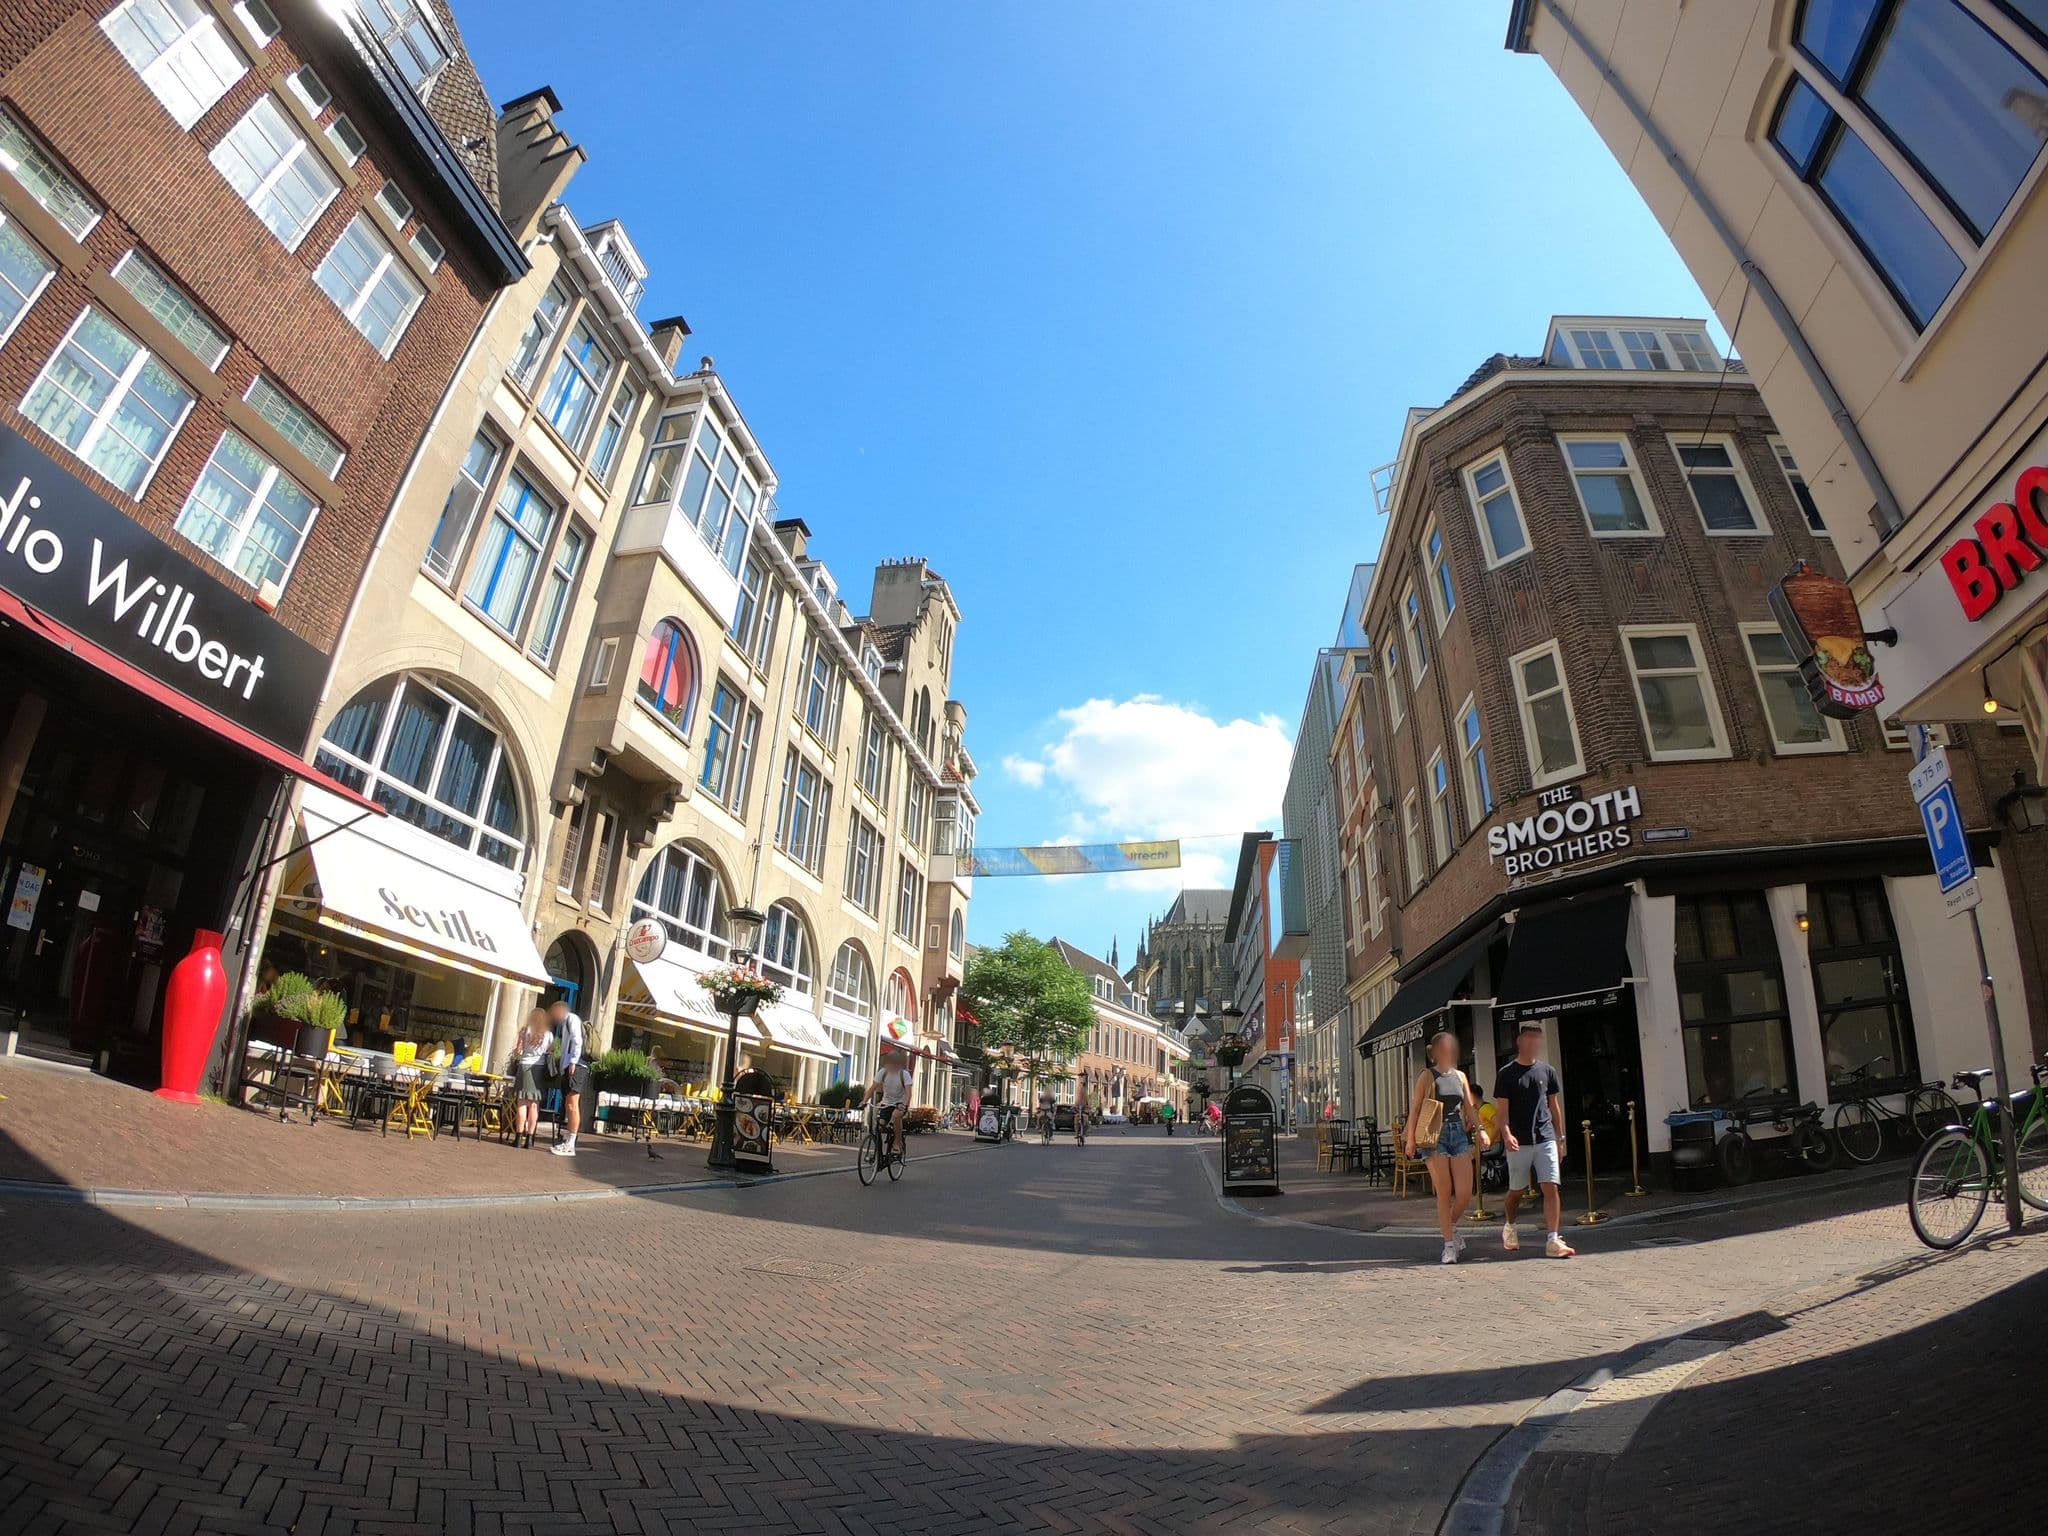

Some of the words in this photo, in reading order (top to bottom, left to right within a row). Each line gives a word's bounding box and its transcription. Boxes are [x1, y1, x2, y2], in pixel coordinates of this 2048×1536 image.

[88, 538, 264, 700] Wilbert
[1832, 685, 1884, 706] BAMBI
[1922, 765, 1935, 782] 75
[1935, 759, 1944, 772] m
[1539, 785, 1574, 807] THE
[1487, 785, 1642, 860] SMOOTH
[1927, 798, 1949, 850] P
[1505, 826, 1632, 876] BROTHERS
[378, 887, 498, 953] Sevilla
[1562, 999, 1597, 1010] BROTHERS
